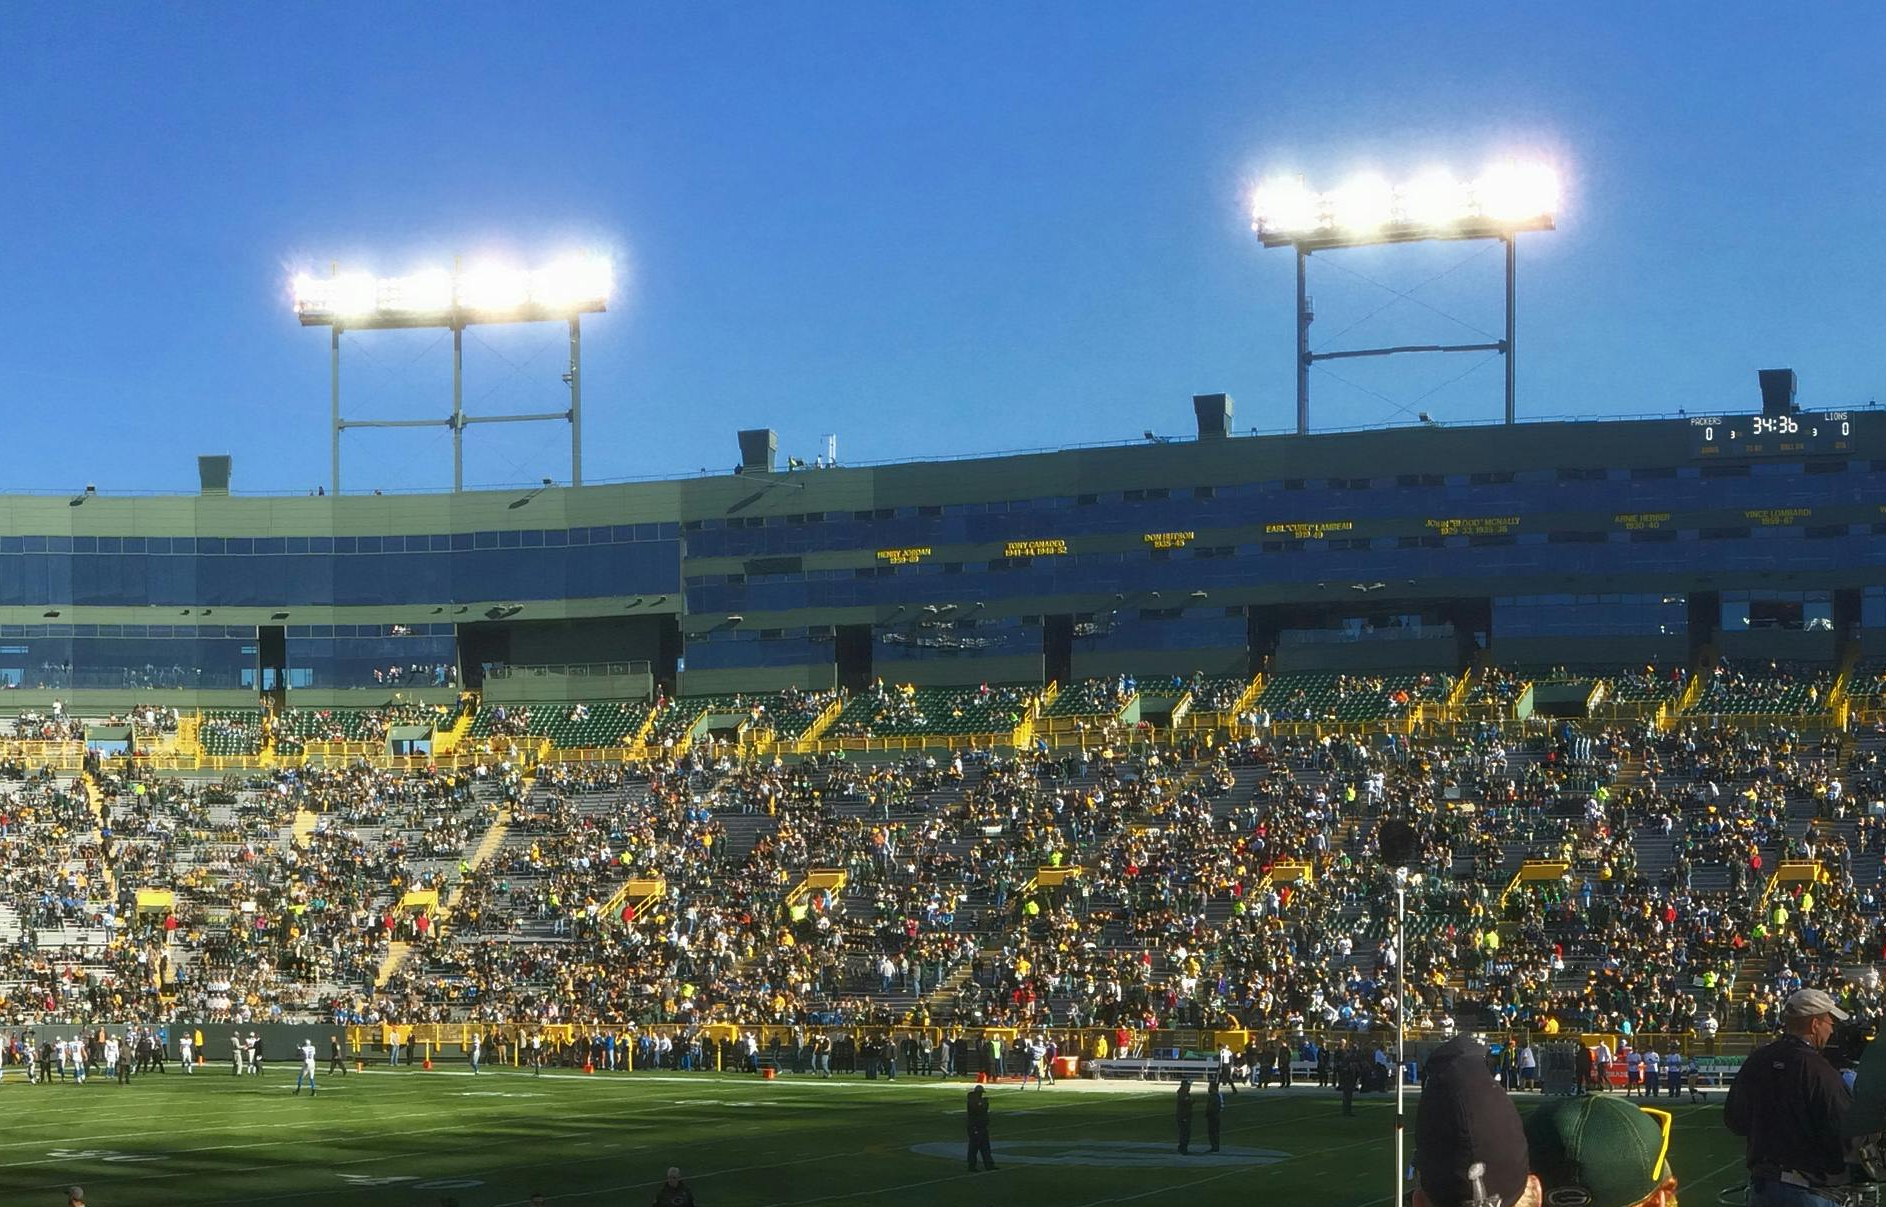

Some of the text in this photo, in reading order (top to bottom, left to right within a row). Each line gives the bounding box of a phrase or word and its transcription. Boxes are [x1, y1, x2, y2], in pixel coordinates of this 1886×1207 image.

[1825, 412, 1848, 421] LIONS
[1690, 417, 1722, 426] PACKERS
[1753, 415, 1799, 435] 34:36
[1144, 533, 1162, 541] DON
[1008, 540, 1065, 550] TONY CANADEO
[877, 548, 931, 559] HENRY JORDAN
